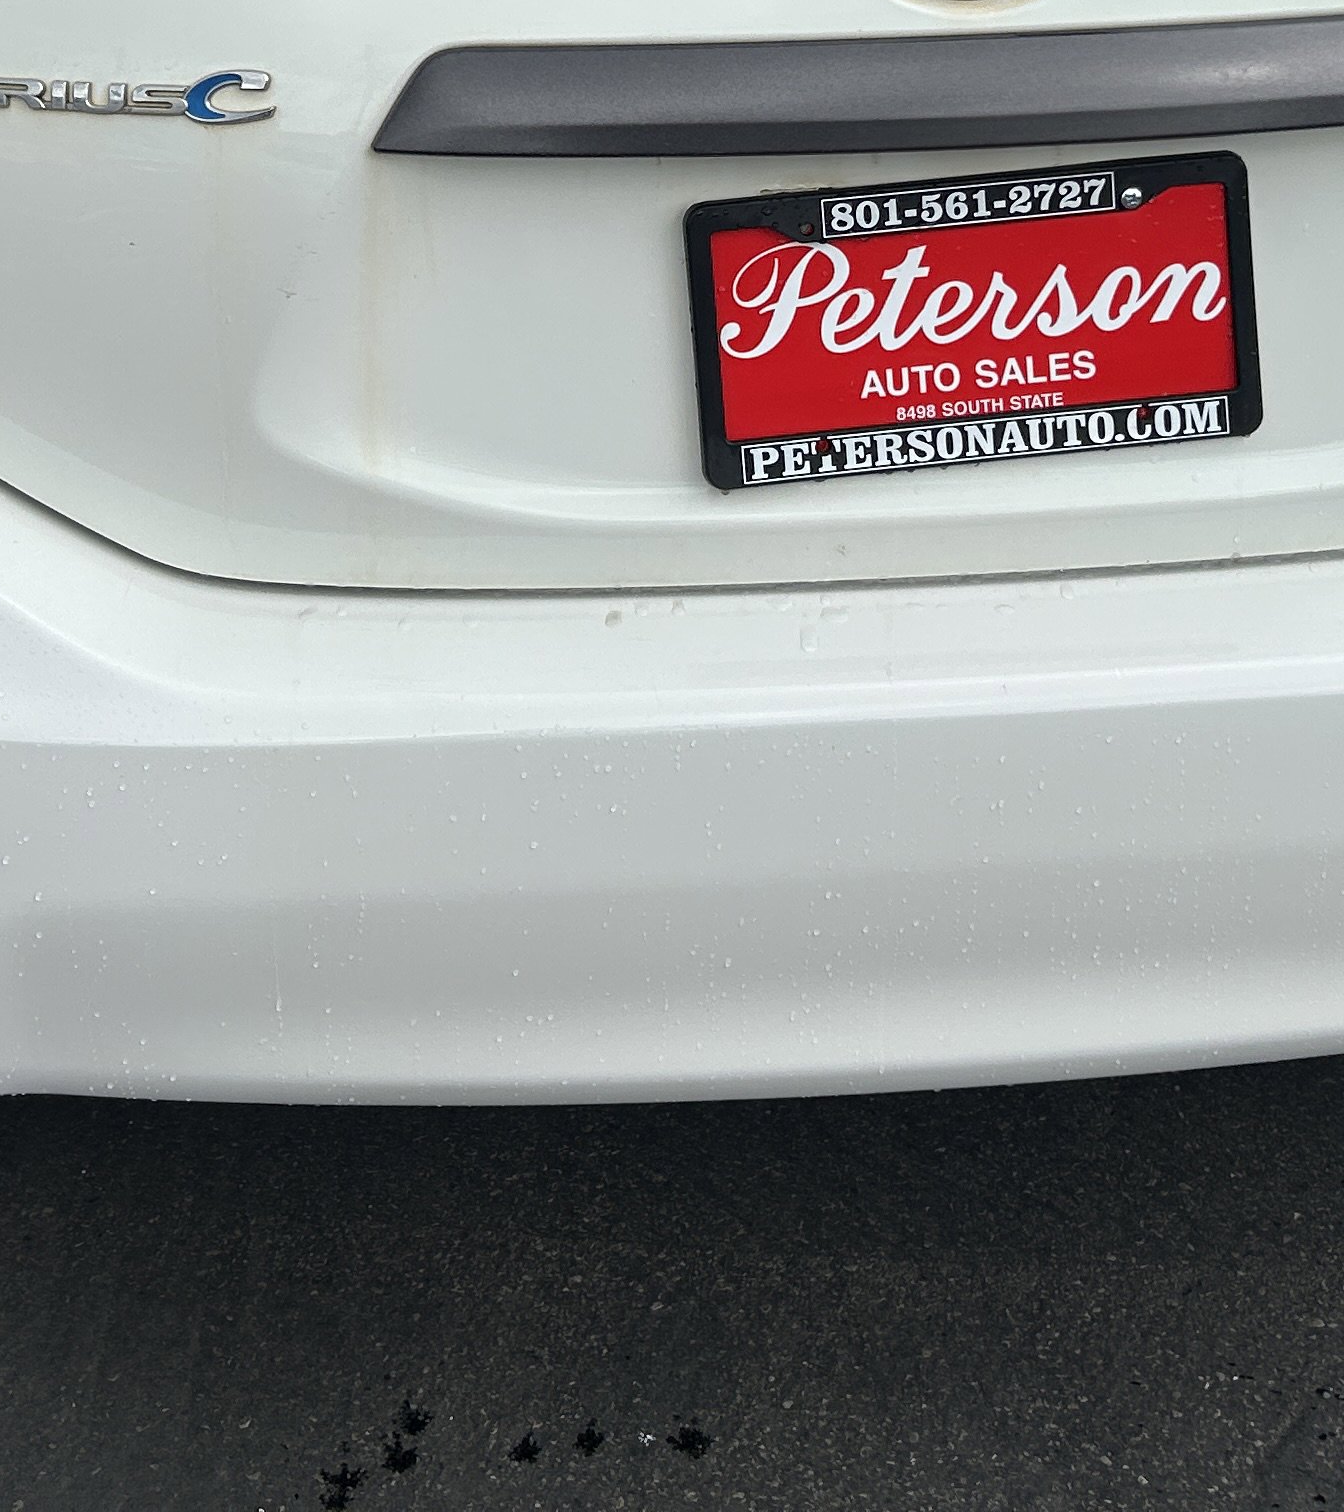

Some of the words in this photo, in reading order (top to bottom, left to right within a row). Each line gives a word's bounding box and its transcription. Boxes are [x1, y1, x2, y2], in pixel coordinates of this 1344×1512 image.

[829, 178, 1107, 231] 801-561-2727
[720, 240, 1227, 360] Peterson
[861, 361, 961, 399] AUTO
[975, 350, 1096, 389] SALES
[896, 403, 936, 421] 8498
[942, 397, 1004, 419] SOUTH
[1010, 392, 1064, 413] STATE
